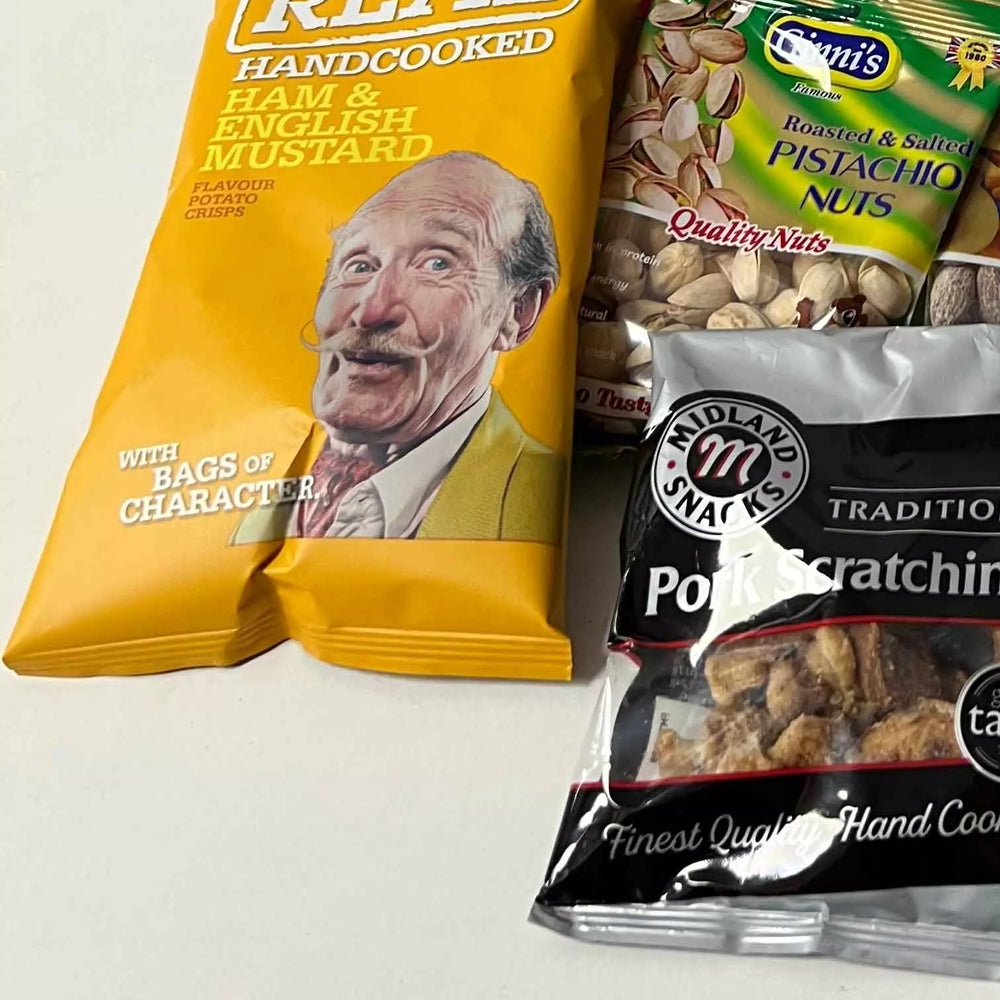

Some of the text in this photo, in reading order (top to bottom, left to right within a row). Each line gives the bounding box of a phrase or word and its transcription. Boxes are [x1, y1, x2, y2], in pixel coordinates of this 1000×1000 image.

[232, 27, 556, 83] HANDCOOKED
[965, 52, 987, 62] 1980
[220, 82, 381, 116] HAM &
[793, 82, 842, 101] Famous
[209, 105, 419, 142] ENGLISH
[782, 114, 976, 158] Roasted & Salted
[199, 134, 435, 172] MUSTARD
[766, 140, 964, 192] PISTACHIO
[188, 192, 259, 207] POTATO
[191, 178, 276, 193] FLAVOUR
[799, 184, 897, 219] NUTS
[184, 206, 246, 220] CRISPS
[667, 207, 831, 254] Quality Nuts
[666, 403, 799, 463] MIDLAND
[119, 442, 180, 470] WITH
[151, 452, 275, 493] BAGS OF
[119, 474, 321, 525] CHARACTER.
[663, 479, 786, 527] SNACKS
[602, 821, 703, 861] Finest
[837, 804, 932, 844] Hand
